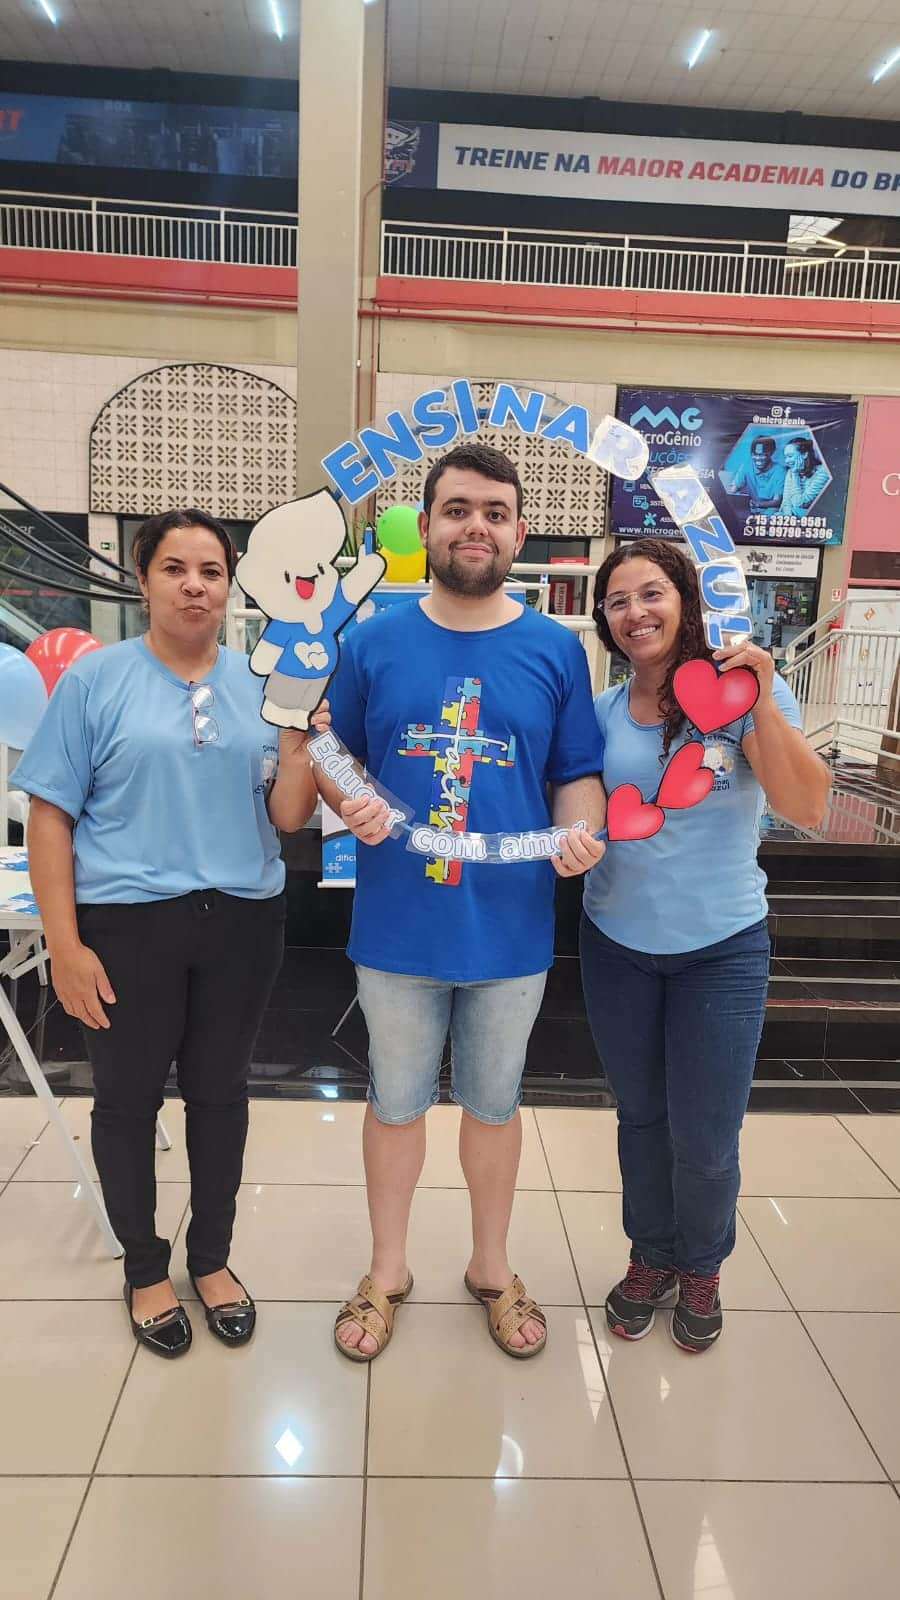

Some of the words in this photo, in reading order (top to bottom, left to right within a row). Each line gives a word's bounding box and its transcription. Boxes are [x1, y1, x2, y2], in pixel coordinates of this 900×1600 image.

[455, 146, 549, 172] TREINE
[554, 153, 590, 174] NA
[597, 155, 683, 179] MAIOR
[688, 161, 825, 187] ACADEMIA
[831, 169, 868, 189] DO
[639, 430, 702, 447] icroGênio
[755, 515, 767, 525] 15
[412, 827, 487, 861] com
